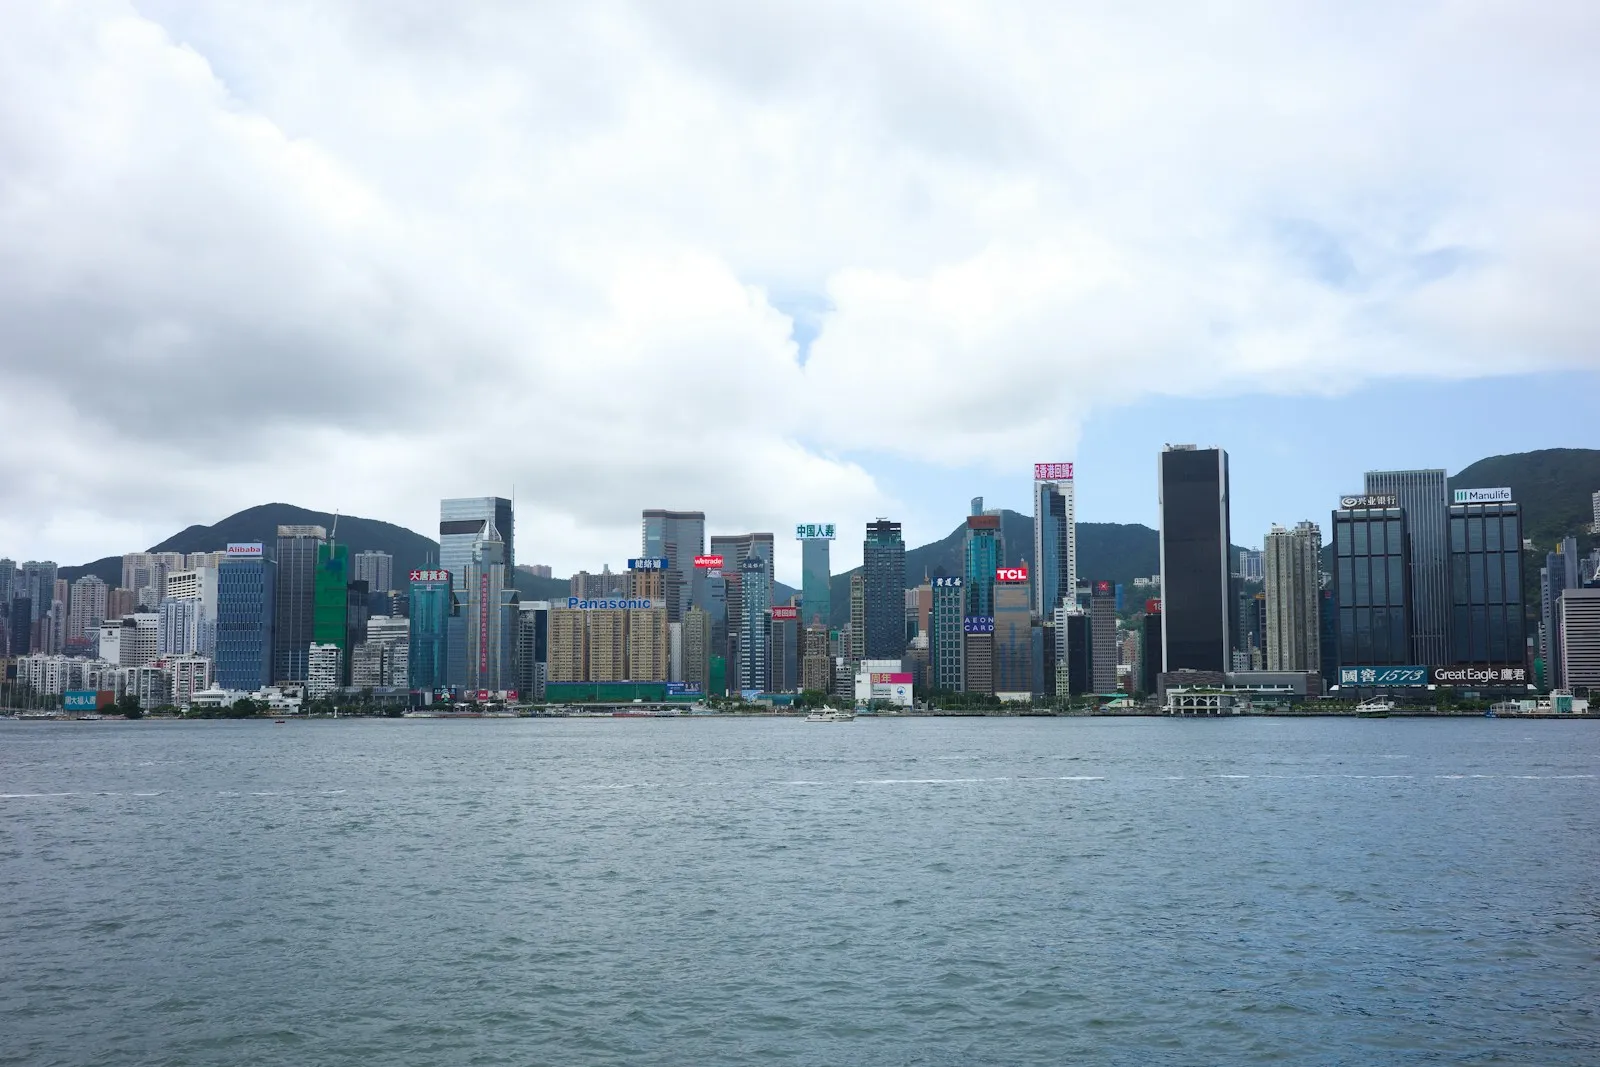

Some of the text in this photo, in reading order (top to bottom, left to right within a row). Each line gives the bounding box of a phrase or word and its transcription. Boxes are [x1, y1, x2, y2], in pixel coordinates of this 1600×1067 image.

[1470, 490, 1509, 500] Manulife
[797, 524, 834, 537] 中国人寿
[996, 570, 1026, 580] TCL
[568, 597, 650, 609] Panasonic
[1435, 668, 1525, 682] Great Eagle 鷹君
